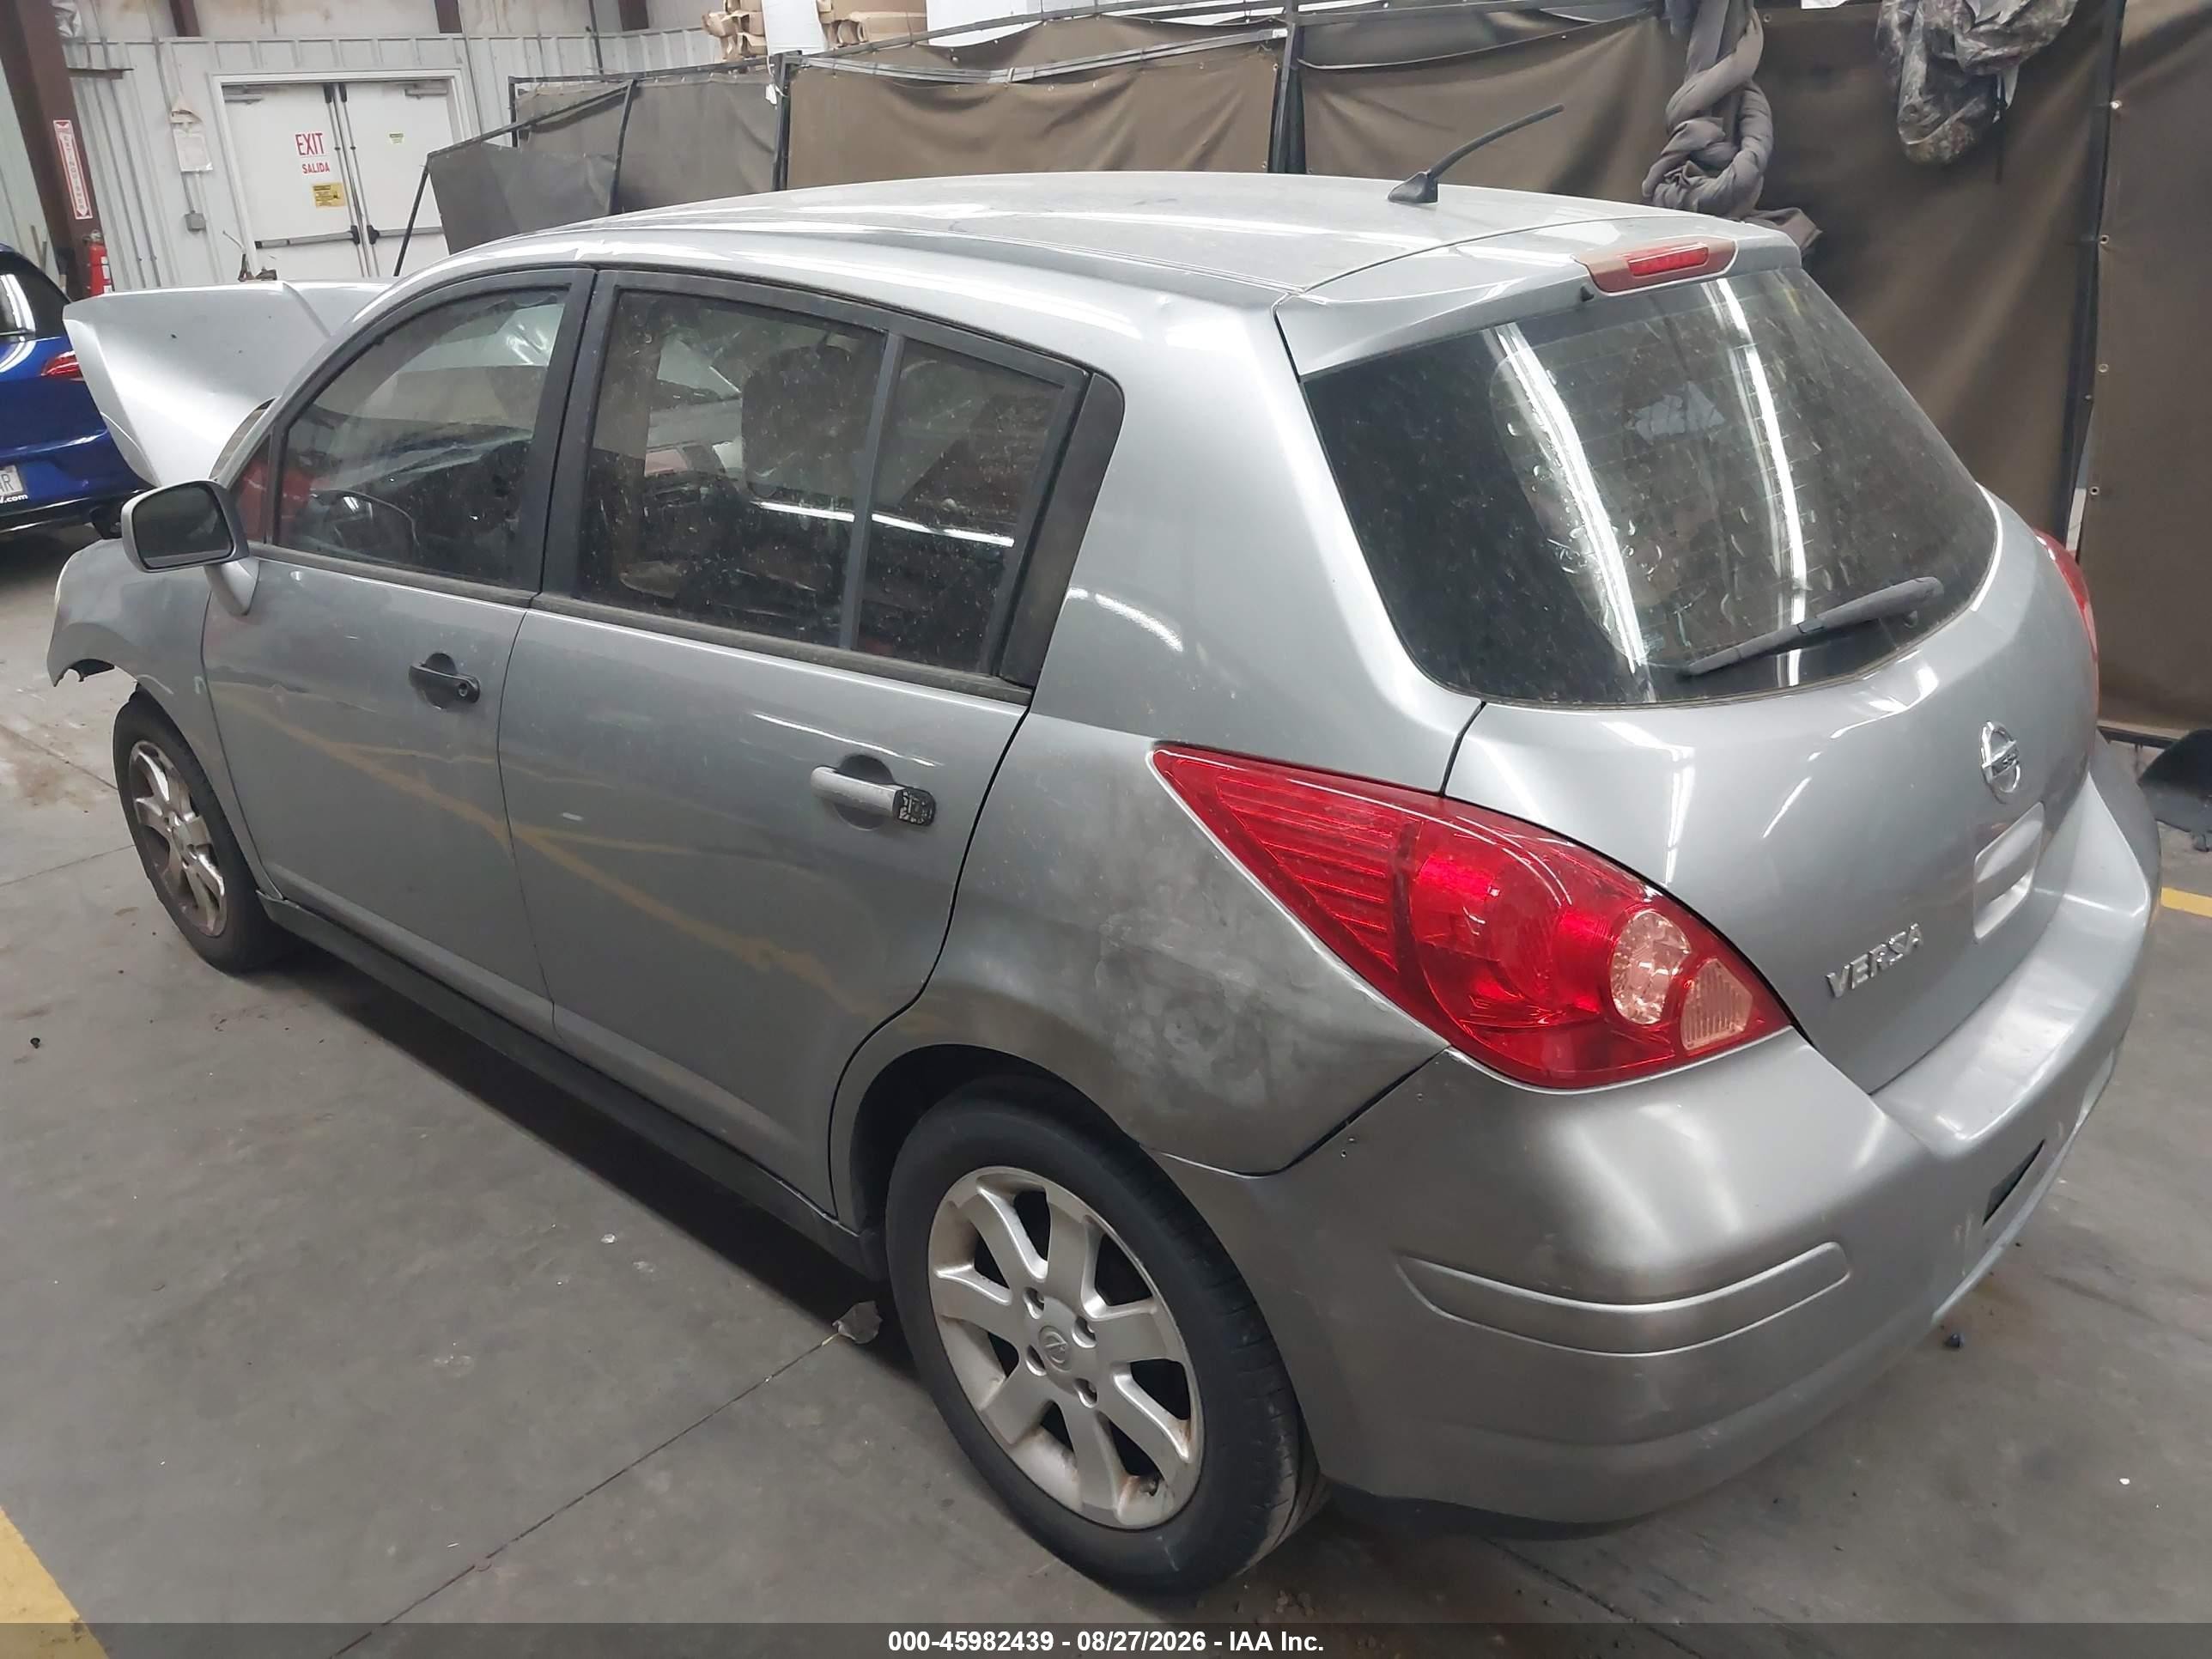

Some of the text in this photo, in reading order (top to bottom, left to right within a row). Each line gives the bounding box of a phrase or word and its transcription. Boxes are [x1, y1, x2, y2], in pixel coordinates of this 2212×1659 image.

[295, 132, 325, 155] EXIT
[301, 161, 331, 174] SALIDA
[1825, 922, 1923, 997] VERSA
